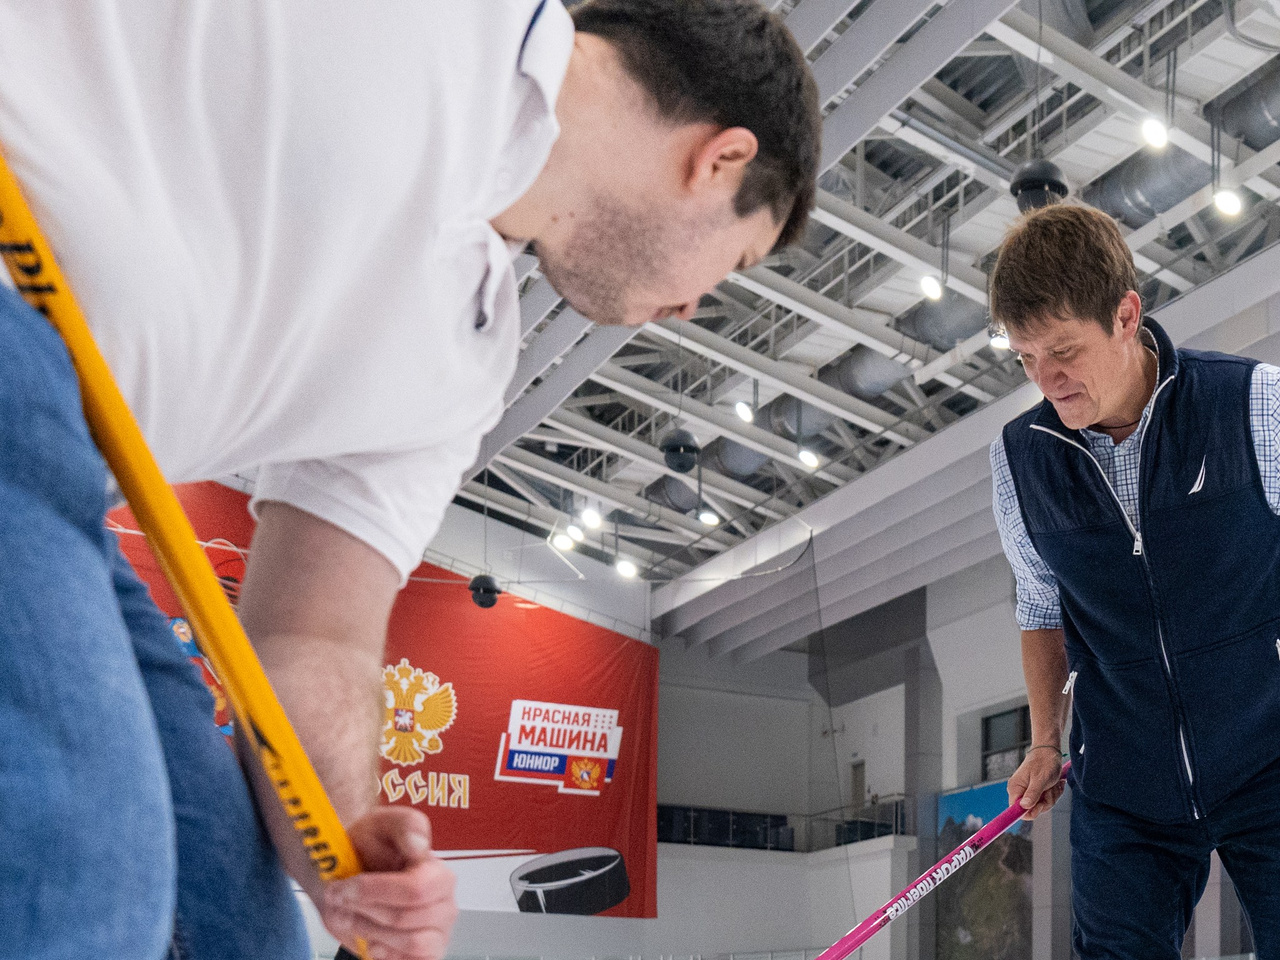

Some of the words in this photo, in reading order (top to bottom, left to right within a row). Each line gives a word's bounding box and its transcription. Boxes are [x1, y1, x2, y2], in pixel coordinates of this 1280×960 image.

[521, 706, 591, 727] КРАСНАЯ
[517, 725, 608, 752] МАШИНА
[513, 753, 559, 771] ЮНИОР
[376, 768, 470, 809] ССИЯ
[932, 845, 975, 884] VAPOR
